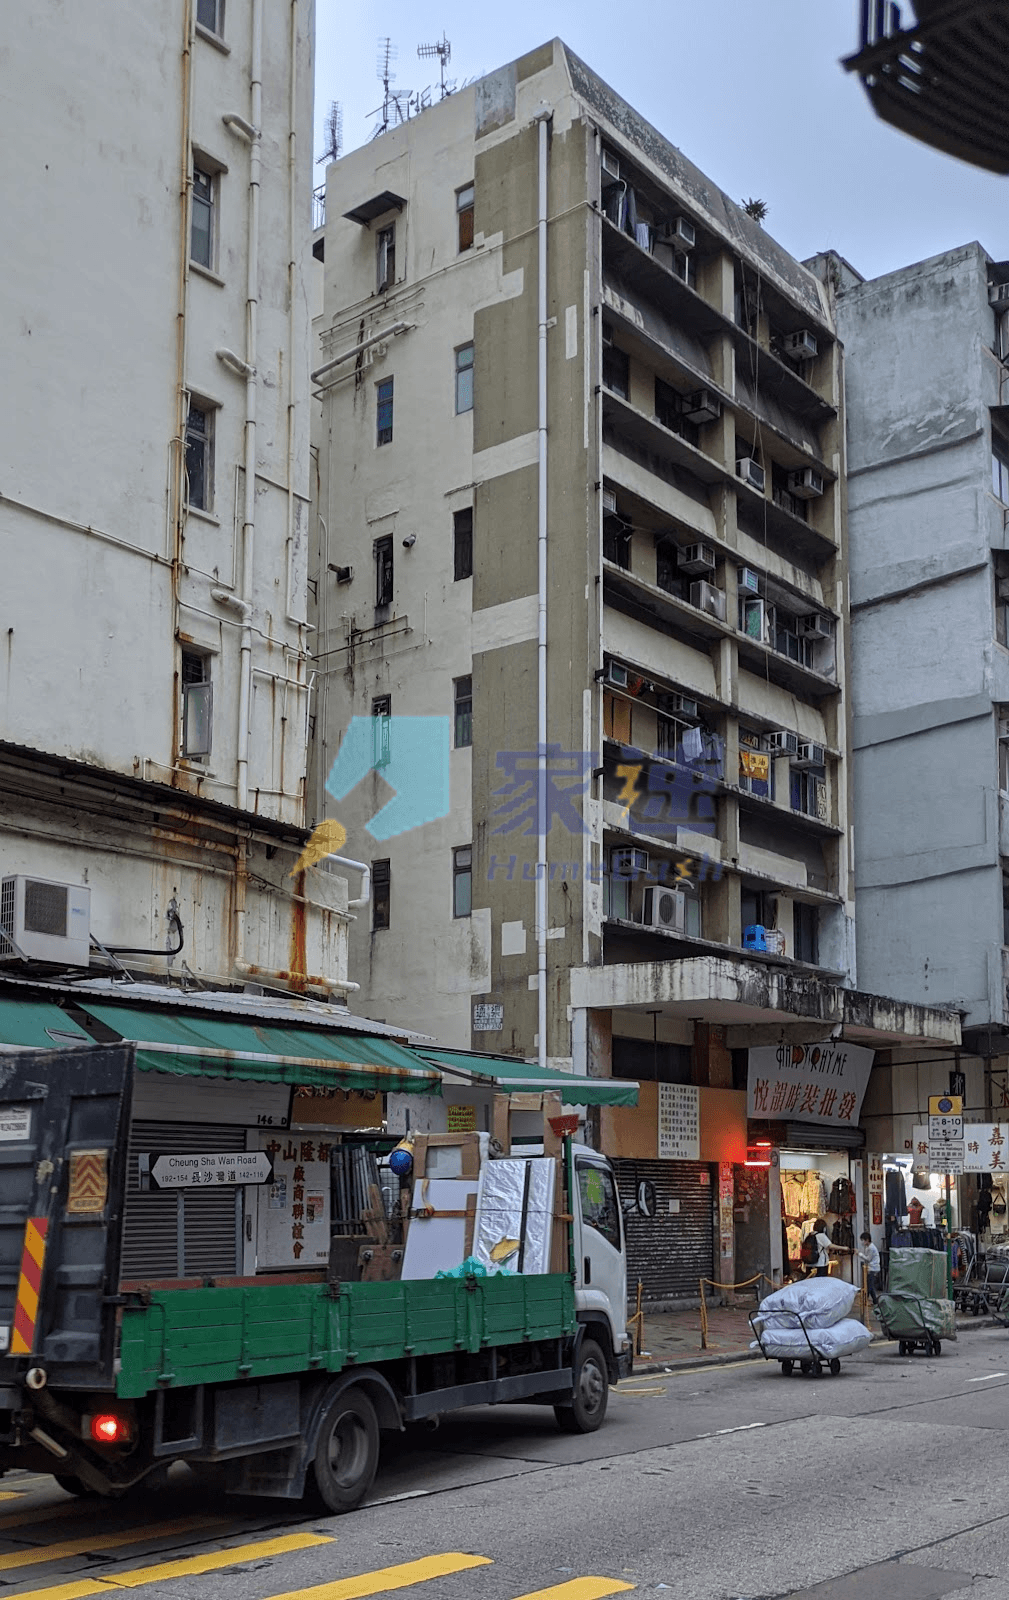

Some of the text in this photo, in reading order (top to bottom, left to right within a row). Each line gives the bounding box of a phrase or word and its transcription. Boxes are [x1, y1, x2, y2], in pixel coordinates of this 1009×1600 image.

[257, 1114, 287, 1125] 146 D
[941, 1118, 961, 1126] 8-10
[988, 1126, 1006, 1170] 嘉美
[169, 1155, 257, 1168] Cheung Sha Wan Road
[161, 1174, 188, 1183] 192-154
[239, 1171, 264, 1179] 142-116
